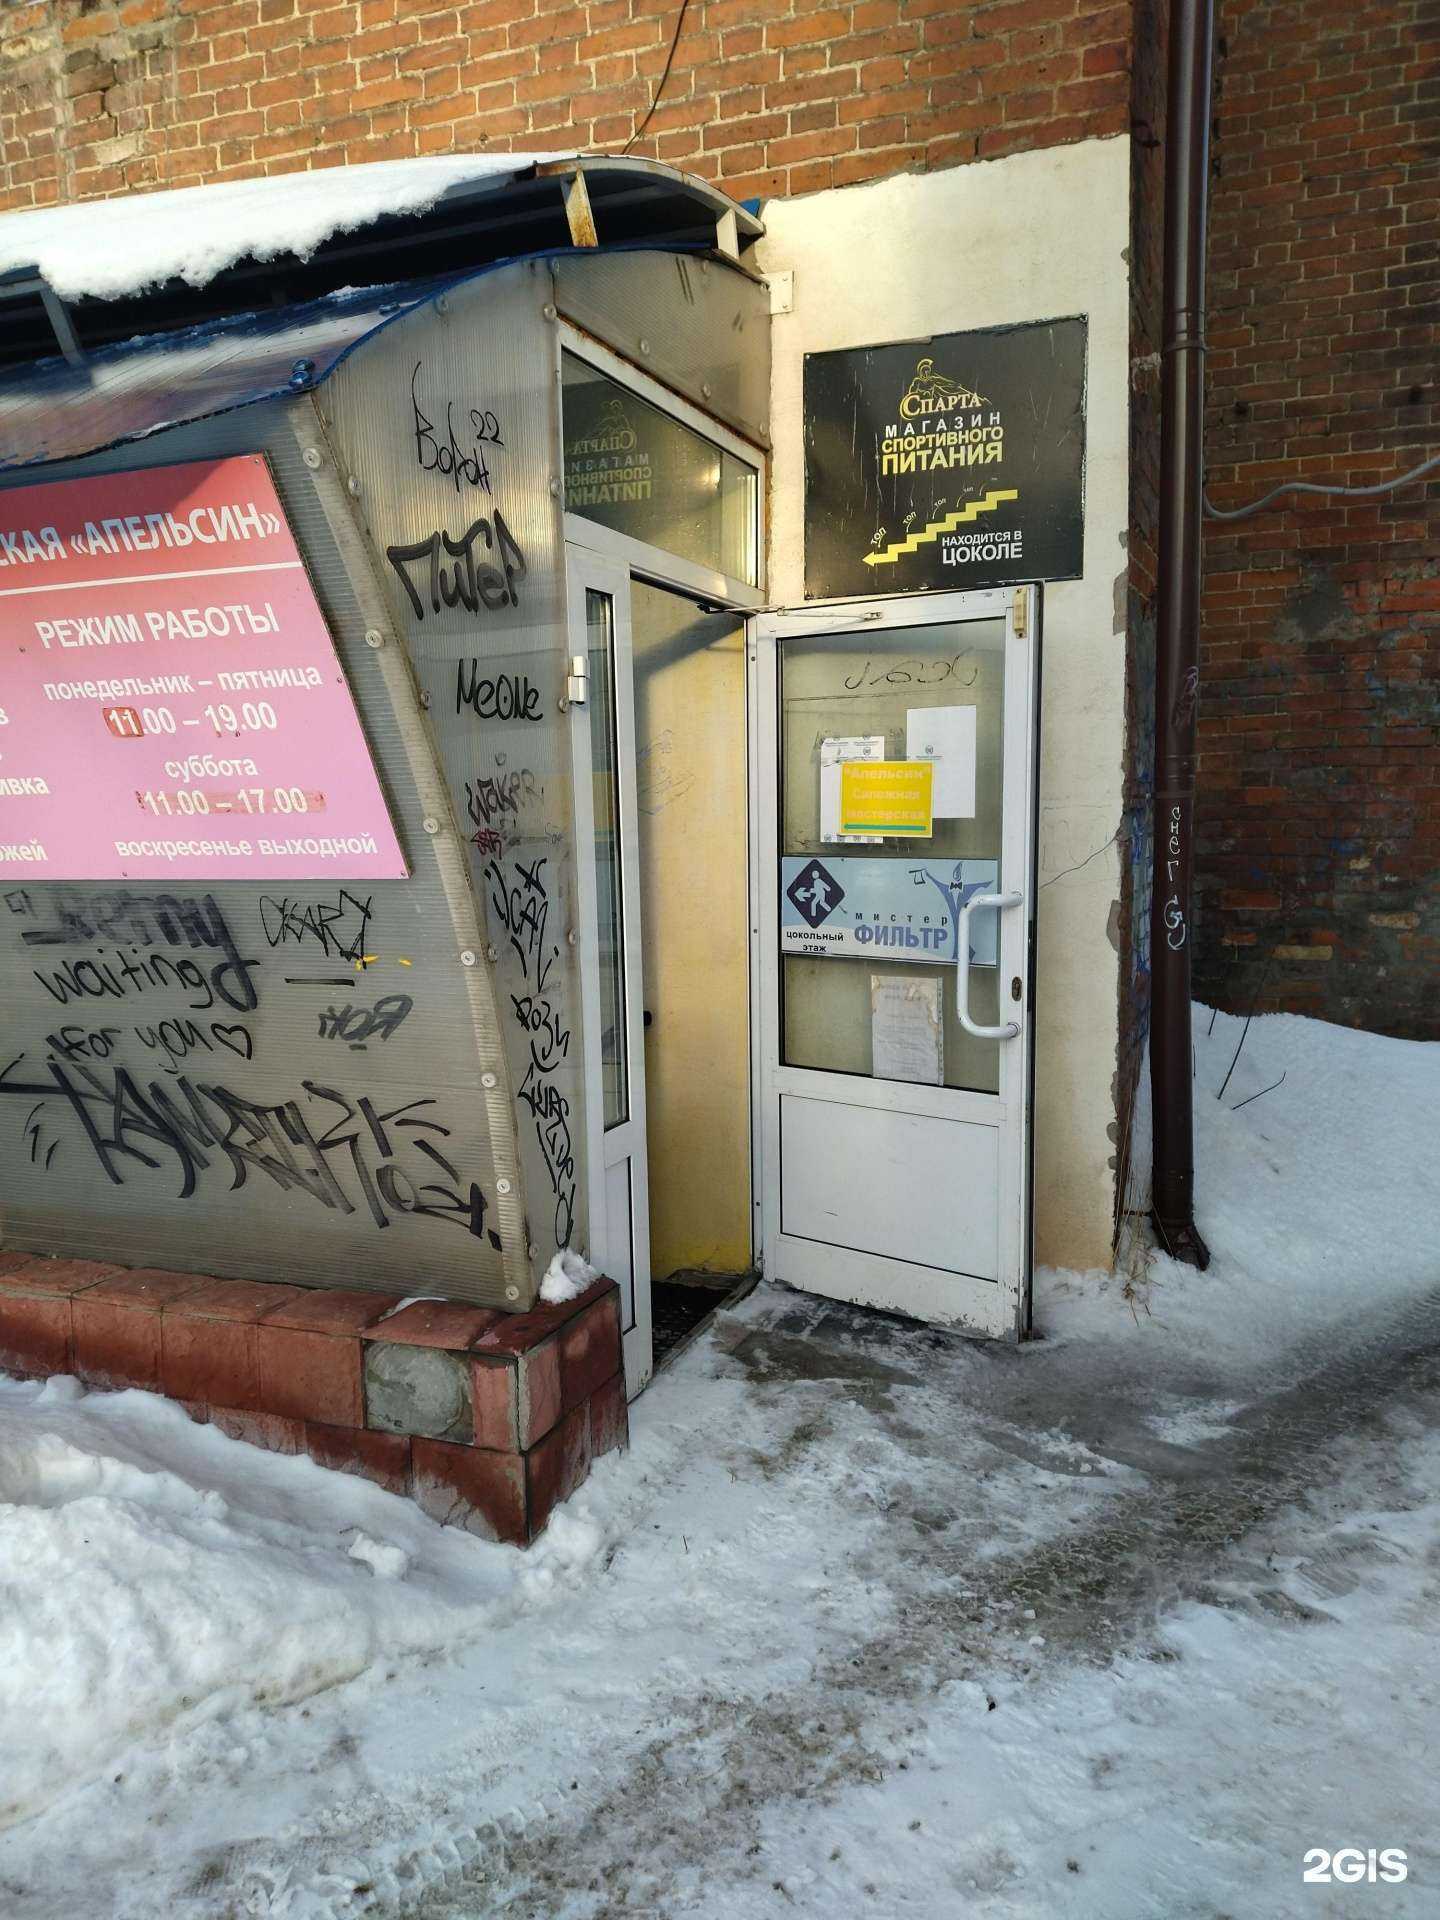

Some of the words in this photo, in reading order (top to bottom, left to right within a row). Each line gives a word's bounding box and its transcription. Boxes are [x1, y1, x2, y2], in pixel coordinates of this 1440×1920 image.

[885, 411, 1000, 438] МАГАЗИН
[882, 426, 1003, 454] СПОРТИВНОГО
[882, 442, 1003, 475] ПИТАНИЯ
[70, 502, 280, 556] «АПЕЛЬСИН»
[942, 532, 1011, 547] НАХОДИТСЯ
[1014, 530, 1022, 540] В
[942, 542, 1023, 566] ЦОКОЛЕ
[34, 613, 144, 649] РЕЖИМ
[149, 602, 280, 642] РАБОТЫ
[43, 673, 195, 702] понедельник
[217, 666, 322, 694] пятница
[108, 706, 177, 737] 11.00
[205, 701, 278, 733] 19.00
[164, 753, 259, 783] суббота
[143, 789, 211, 817] 11.00
[237, 787, 310, 815] 17.00
[114, 837, 253, 861] воскресенье
[259, 831, 379, 858] выходной
[855, 913, 948, 925] мистер
[786, 931, 844, 942] цокольный
[802, 944, 827, 952] этаж
[854, 925, 948, 949] ФИЛЬТР
[33, 948, 213, 1008] waiting
[134, 1018, 213, 1075] you
